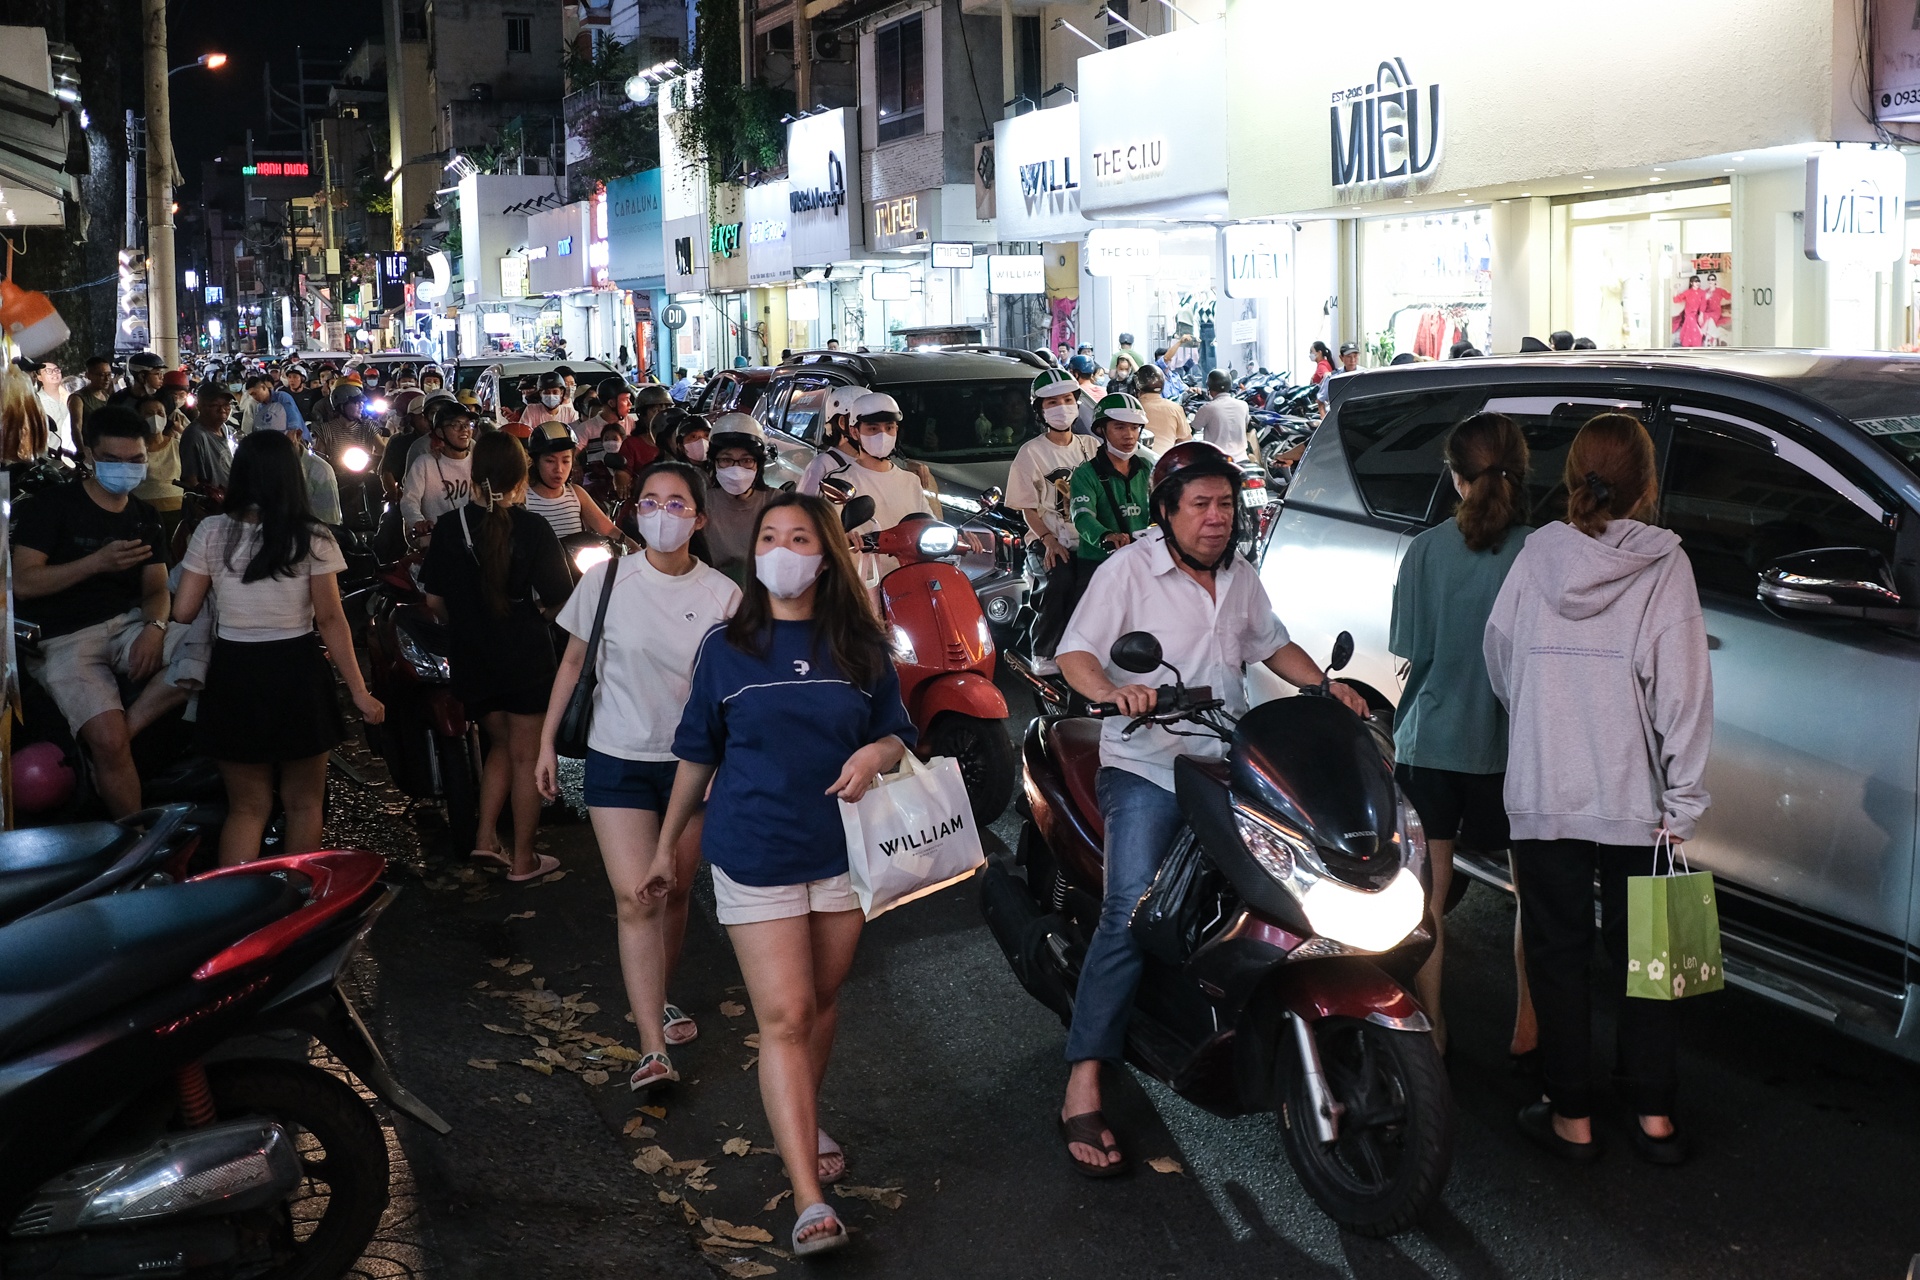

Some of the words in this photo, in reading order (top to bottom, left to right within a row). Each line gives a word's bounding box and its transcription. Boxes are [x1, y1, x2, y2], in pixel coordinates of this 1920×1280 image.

[1094, 150, 1122, 176] THE
[1127, 140, 1161, 170] C.I.U
[283, 163, 309, 176] DUNG
[614, 194, 658, 218] CARALUNA
[996, 271, 1042, 279] WILLIAM
[1752, 287, 1773, 306] 100
[1858, 421, 1886, 434] XE
[879, 814, 964, 857] WILLIAM
[1343, 830, 1378, 839] HONDA
